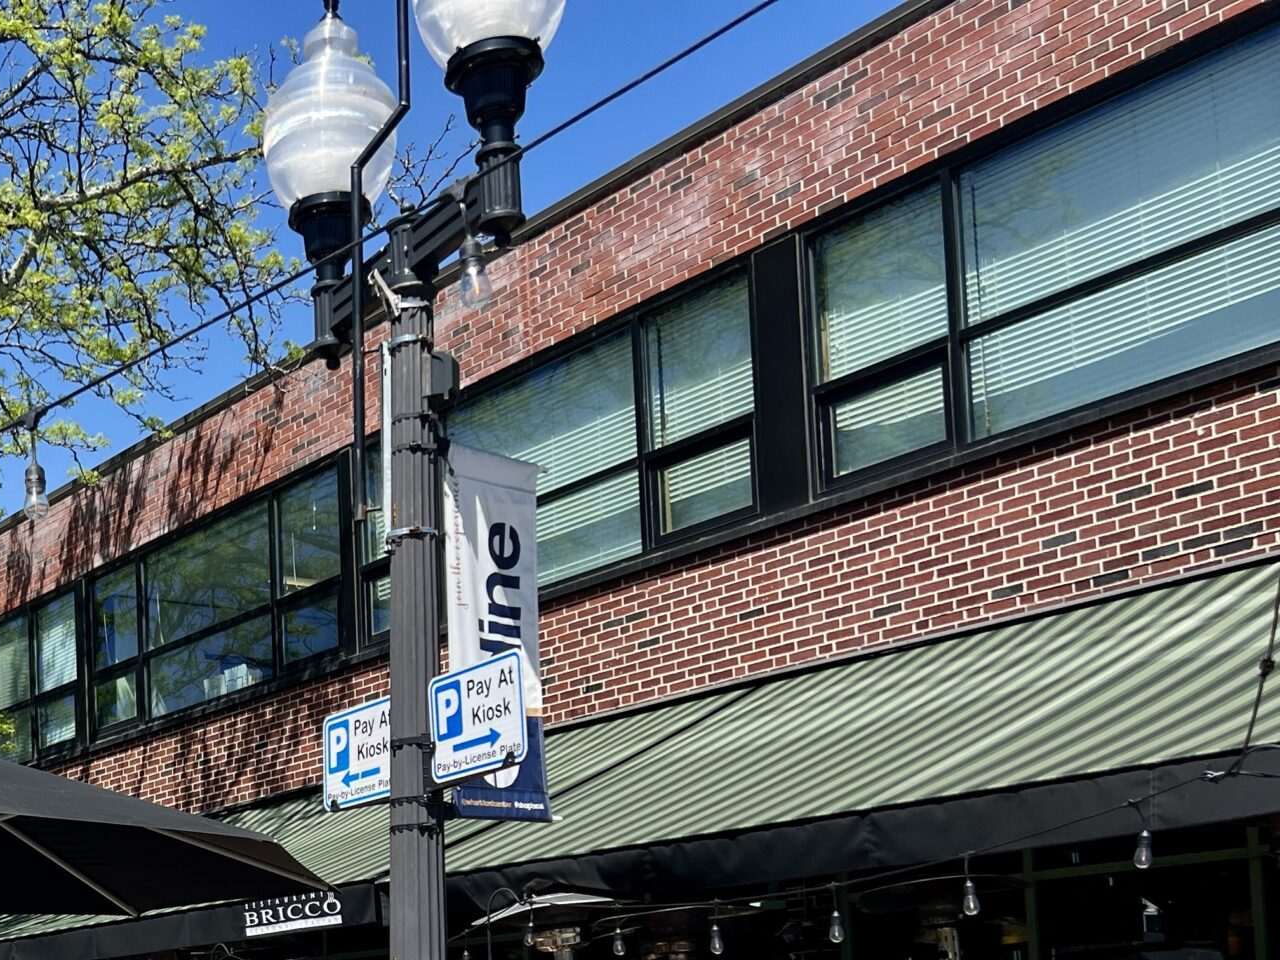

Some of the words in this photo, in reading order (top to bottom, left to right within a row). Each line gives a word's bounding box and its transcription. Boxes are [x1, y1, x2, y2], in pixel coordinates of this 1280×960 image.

[466, 678, 492, 699] Pay
[498, 666, 514, 688] At
[437, 688, 459, 736] P
[472, 697, 512, 726] Kiosk
[354, 718, 375, 737] Pay
[330, 726, 348, 769] P
[357, 737, 389, 761] Kiosk
[436, 749, 497, 773] Pay-by-License
[499, 742, 522, 756] Plate
[327, 782, 376, 801] Pay-by-License
[243, 898, 342, 927] BRICCO
